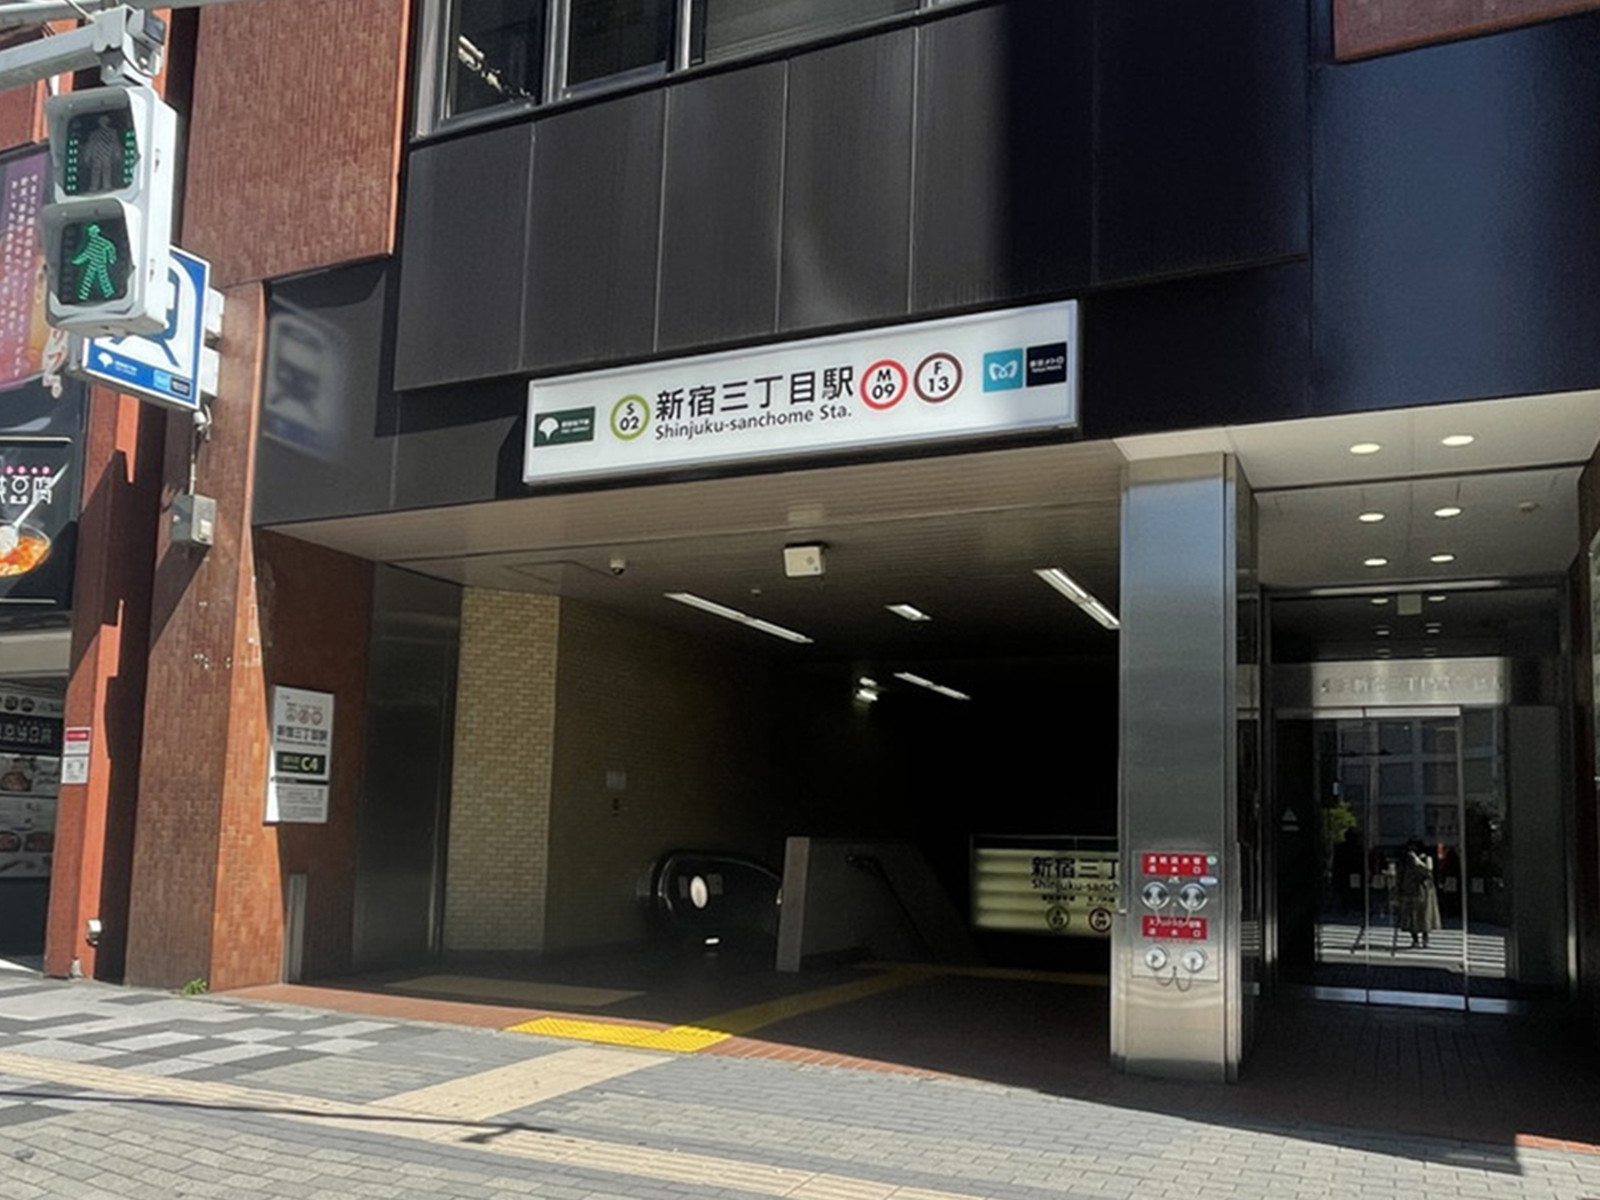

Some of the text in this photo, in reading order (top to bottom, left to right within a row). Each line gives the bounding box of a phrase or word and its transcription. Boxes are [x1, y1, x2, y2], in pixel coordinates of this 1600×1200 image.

[877, 368, 891, 382] M
[934, 361, 942, 375] F
[872, 383, 896, 400] 09
[928, 376, 949, 393] 13
[655, 366, 853, 421] 新宿三丁目駅
[626, 402, 635, 416] S
[619, 417, 639, 431] 02
[655, 404, 852, 440] Shinjuku-sanchome Sta.
[301, 756, 319, 772] C4
